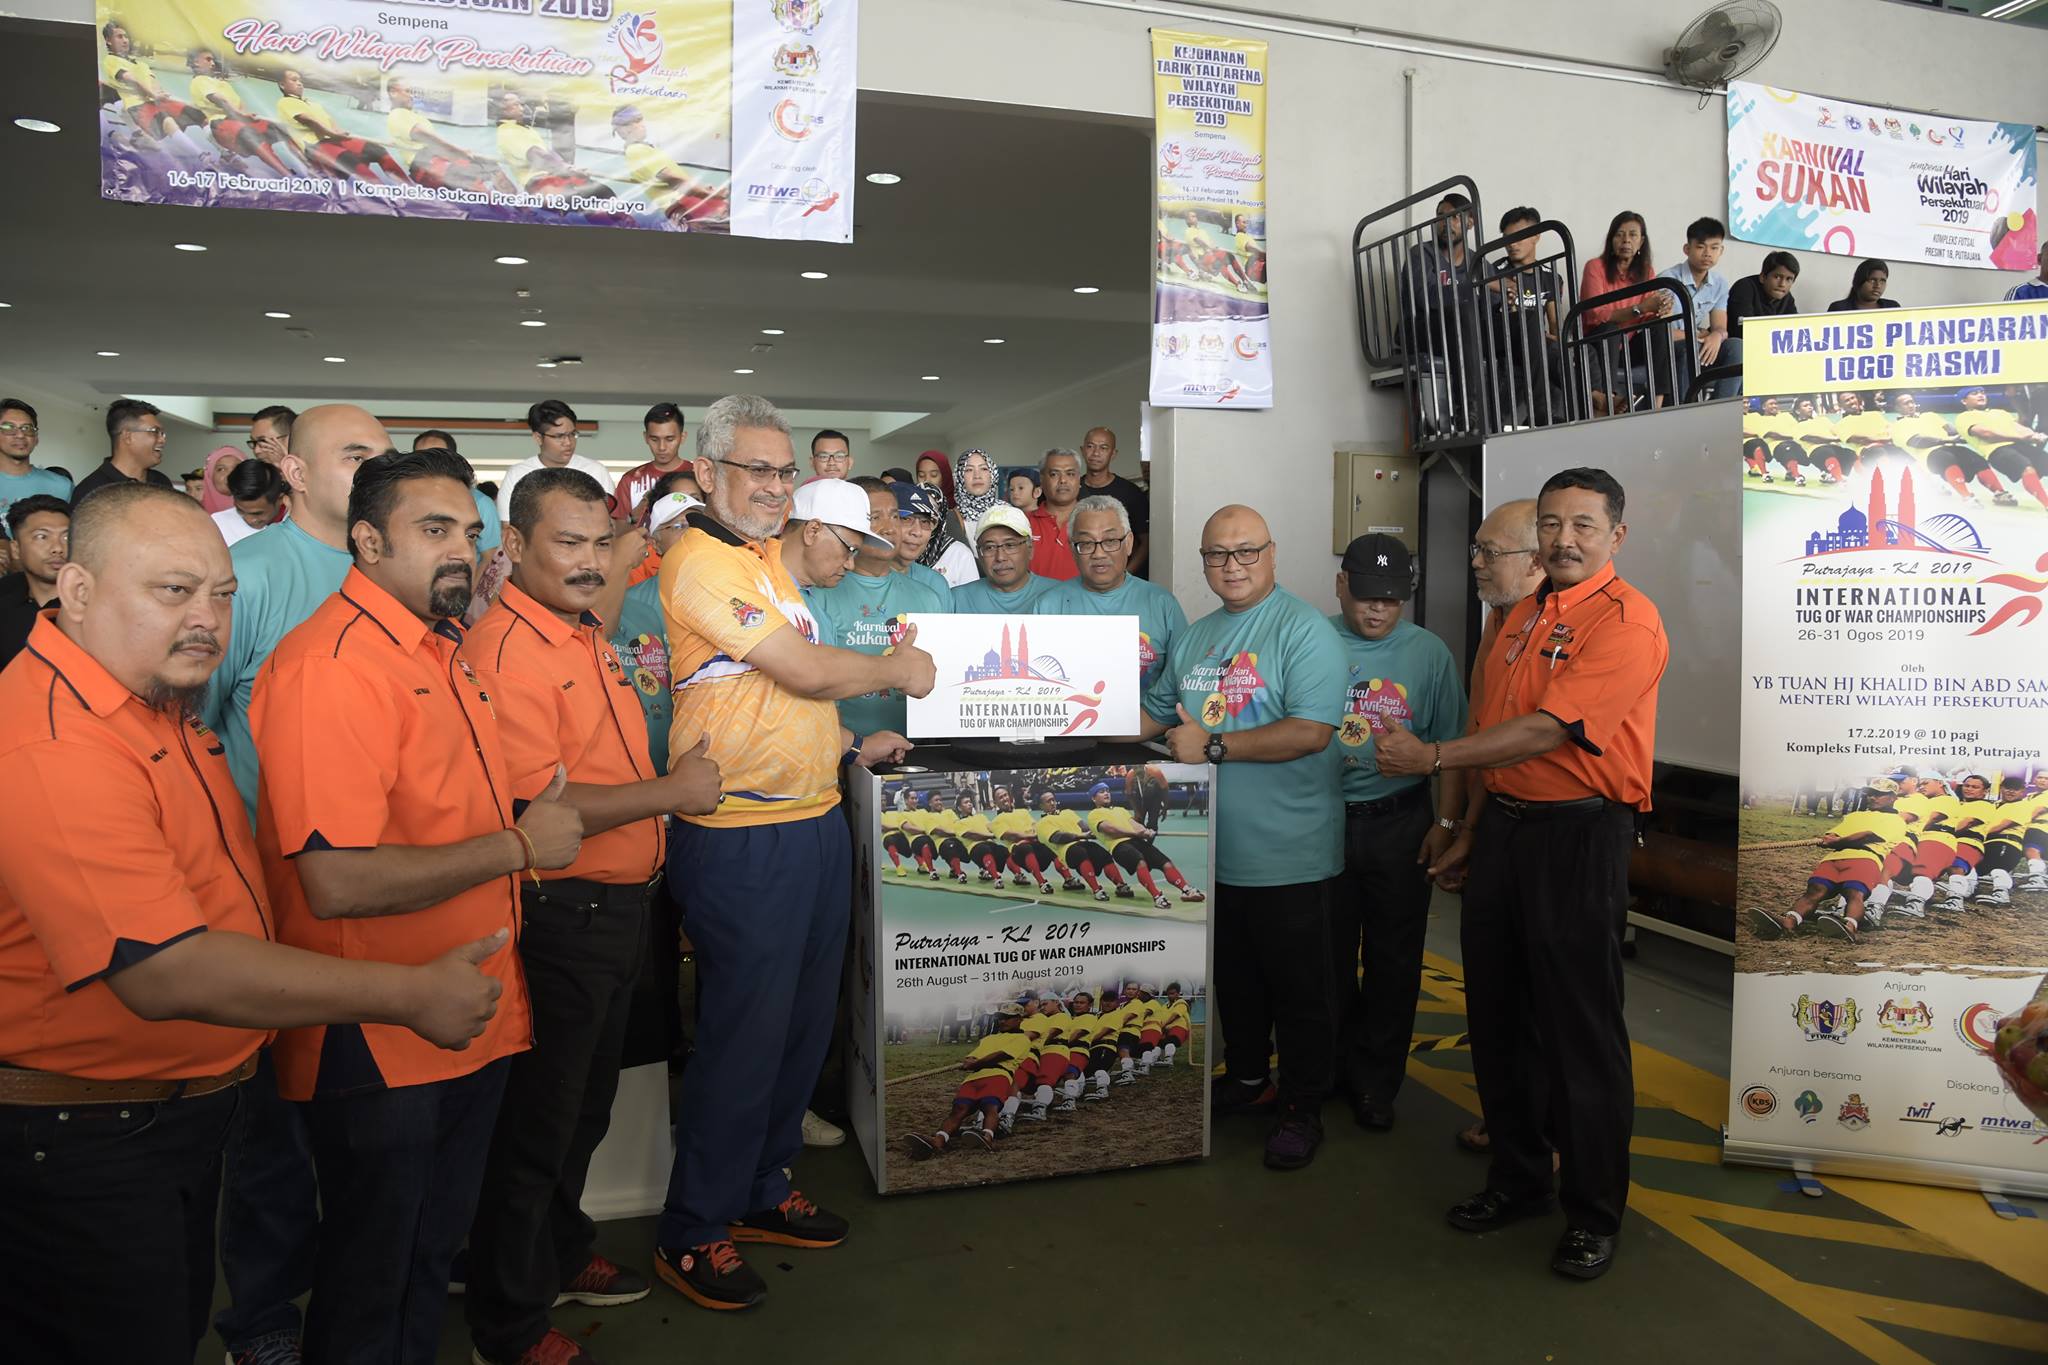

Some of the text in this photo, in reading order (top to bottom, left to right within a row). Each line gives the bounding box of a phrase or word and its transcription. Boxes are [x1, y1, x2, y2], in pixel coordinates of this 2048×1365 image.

[378, 13, 448, 30] Sempena
[225, 20, 592, 74] Hari Wilayah Persekutuan
[1174, 46, 1245, 65] KEJOHANAN
[1157, 60, 1261, 82] TARIK TALI ARENA
[1183, 79, 1235, 95] WILAYAH
[1168, 94, 1250, 113] PERSEKUTUAN
[1195, 111, 1225, 125] 2019
[1194, 131, 1226, 140] Sempena
[1760, 131, 1864, 177] KARNIVAL
[1943, 165, 1970, 181] Hari
[169, 174, 213, 187] 16-17
[220, 176, 288, 192] Februari
[294, 180, 330, 193] 2019
[355, 182, 434, 202] Kompleks
[440, 189, 487, 202] Sukan
[493, 191, 542, 206] Presint
[547, 195, 568, 209] 18,
[574, 198, 644, 213] Putrajaya
[748, 184, 800, 197] mtwa
[1756, 160, 1870, 213] SUKAN
[1917, 174, 1987, 199] Wilayah
[1920, 195, 1986, 211] Persekutuan
[1942, 209, 1969, 224] 2019
[1771, 324, 1874, 354] MAJLIS
[1825, 349, 2000, 382] LOGO RASMI
[1802, 562, 1875, 577] Putrajaya
[1892, 562, 1917, 575] KL
[1930, 562, 1973, 575] 2019
[1796, 587, 1986, 606] INTERNATIONAL
[1796, 609, 1986, 624] TUG OF WAR CHAMPIONSHIPS
[854, 620, 900, 633] Karnival
[846, 631, 892, 646] Sukan
[1798, 629, 1924, 642] 26-31 Ogos 2019
[1901, 664, 1925, 673] Oleh
[962, 686, 1005, 696] Putrajaya
[1015, 687, 1031, 695] KL
[1038, 687, 1061, 695] 2019
[1181, 675, 1219, 691] Sukan
[1752, 676, 1773, 690] YB
[1778, 676, 1827, 690] TUAN
[1834, 677, 1854, 693] HJ
[1861, 677, 1928, 691] KHALID
[1933, 678, 1966, 692] BIN
[1971, 679, 2011, 693] ABD
[1379, 695, 1400, 706] Hari
[1779, 694, 1850, 705] MENTERI
[1856, 695, 1927, 707] WILAYAH
[960, 703, 1069, 717] INTERNATIONAL
[960, 718, 1069, 728] TUG OF WAR CHAMPIONSHIPS
[1848, 728, 1979, 743] 17.2.2019 @ 10 pagi
[1786, 742, 2041, 760] Kompleks Futsal, Presint 18, Putrajaya
[895, 932, 980, 951] Putrajaya
[1001, 924, 1032, 943] KL
[1045, 922, 1091, 940] 2019
[895, 940, 1166, 970] INTERNATIONAL TUG OF WAR CHAMPIONSHIPS
[896, 977, 923, 988] 26th
[926, 974, 967, 987] August
[982, 971, 1009, 982] 31th
[1011, 968, 1051, 981] August
[1055, 965, 1084, 976] 2019
[1883, 981, 1926, 993] Anjuran
[1882, 1037, 1926, 1045] KEMENTERIAN
[1895, 1044, 1942, 1053] PERSEKUTUAN
[1768, 1065, 1862, 1082] Anjuran bersama
[1947, 1080, 1999, 1095] Disokong
[1981, 1116, 2032, 1129] mtwa
